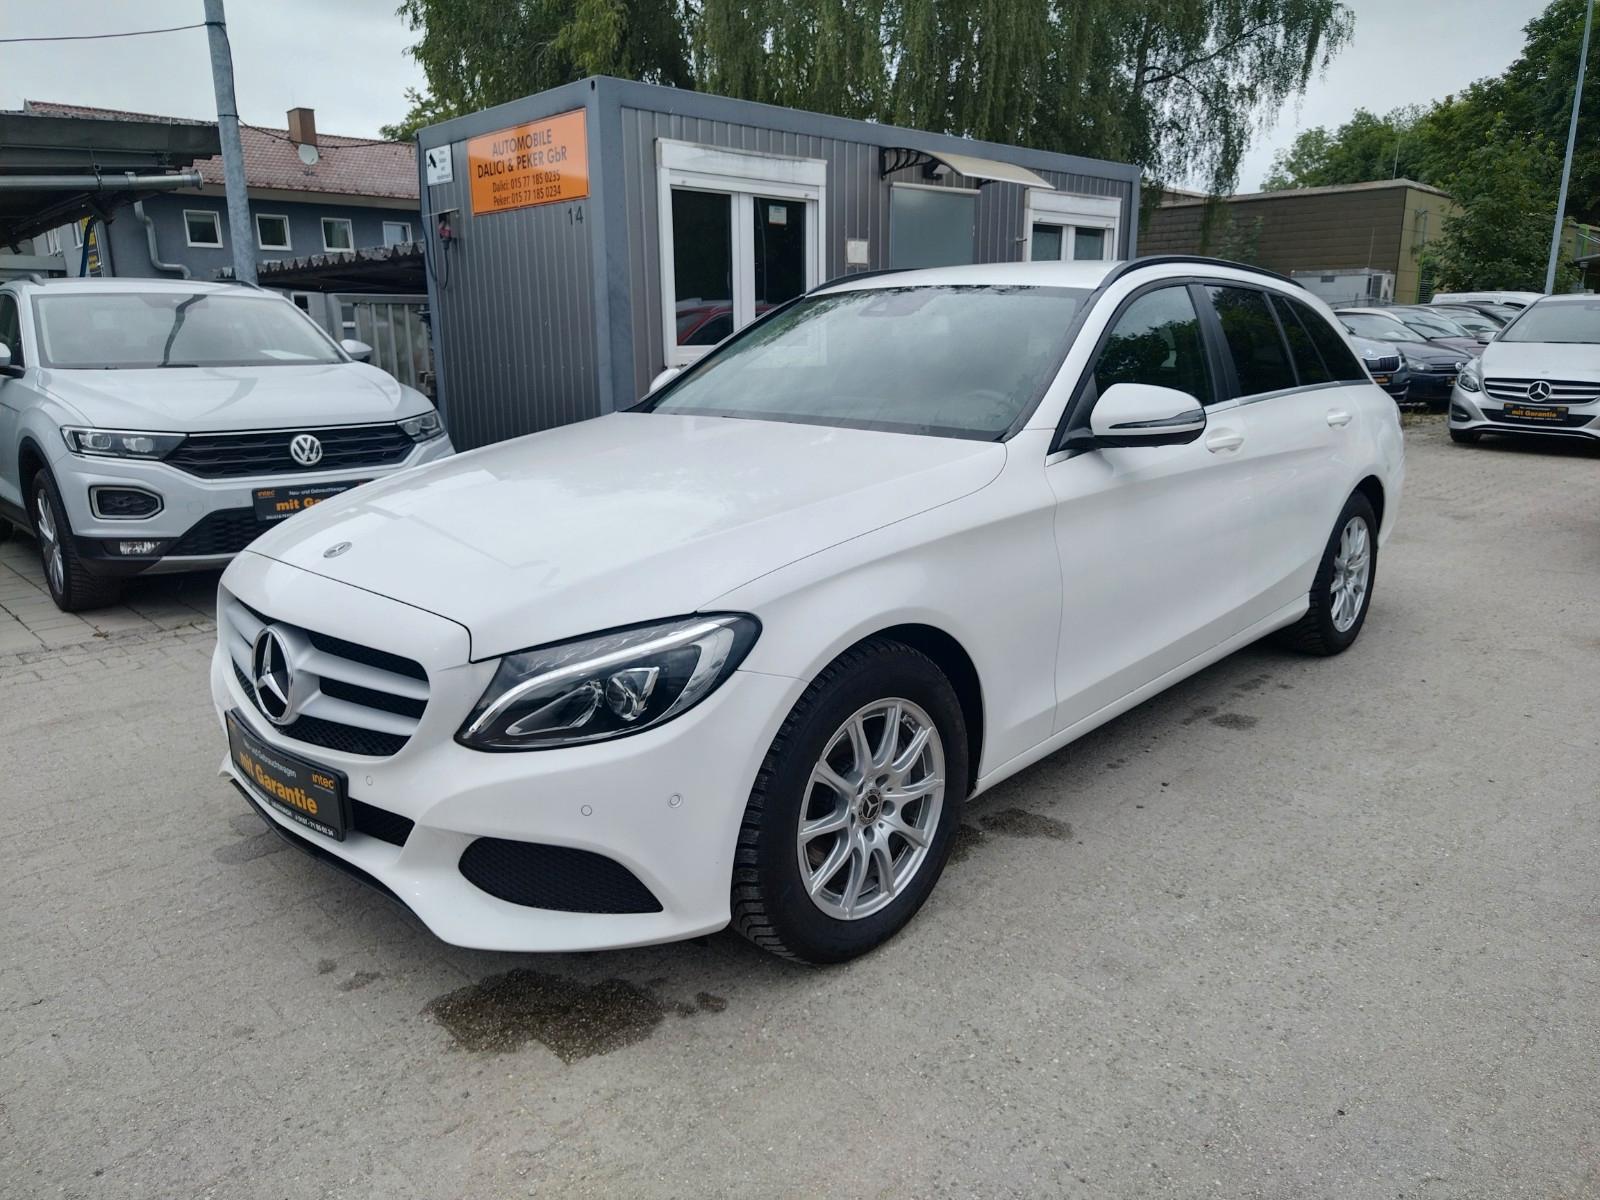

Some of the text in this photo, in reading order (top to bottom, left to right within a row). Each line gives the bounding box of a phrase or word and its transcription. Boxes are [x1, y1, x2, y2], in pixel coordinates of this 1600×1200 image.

[492, 129, 552, 157] AUTOMOBILE
[477, 145, 567, 178] DALICI & PEKER GbR
[511, 178, 521, 190] 015
[523, 176, 530, 187] 77
[511, 191, 522, 204] 015
[524, 190, 531, 201] 77
[567, 206, 584, 224] 14
[276, 498, 300, 512] mit
[255, 763, 318, 816] Garantie
[312, 774, 335, 790] intec
